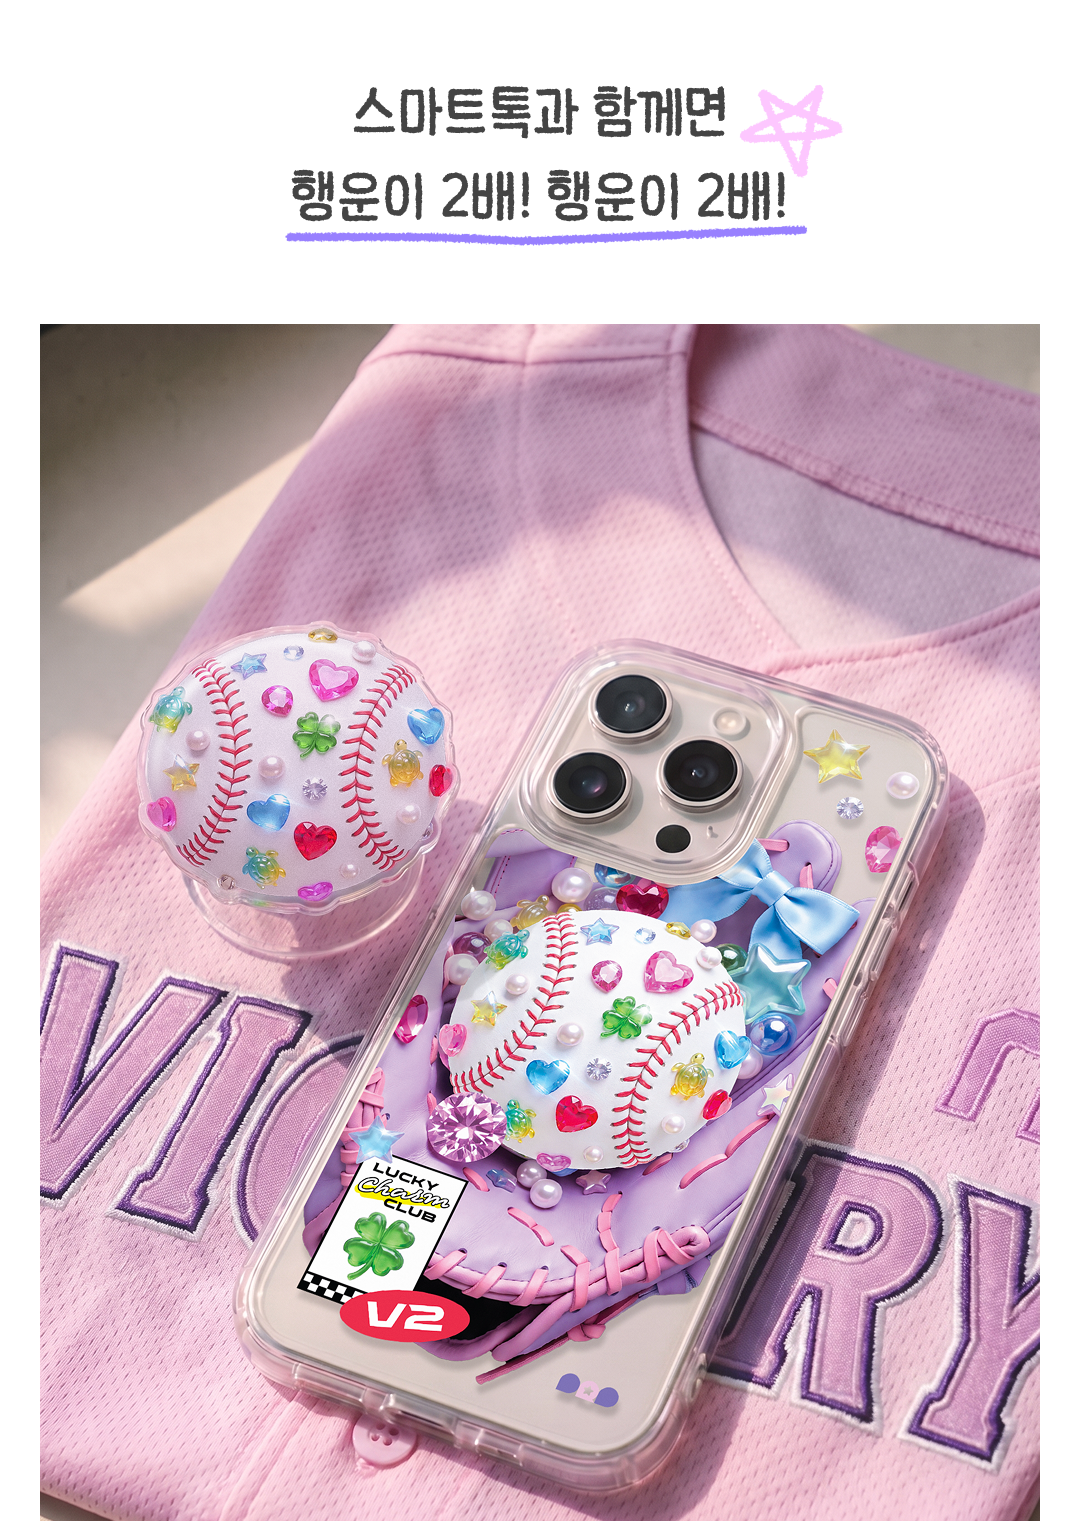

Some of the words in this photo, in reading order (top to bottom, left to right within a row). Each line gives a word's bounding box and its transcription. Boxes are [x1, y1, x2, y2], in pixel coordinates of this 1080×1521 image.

[372, 1162, 440, 1191] LUCKY
[357, 1176, 450, 1209] Charm
[383, 1198, 437, 1223] CLUB
[367, 1301, 445, 1332] V2
